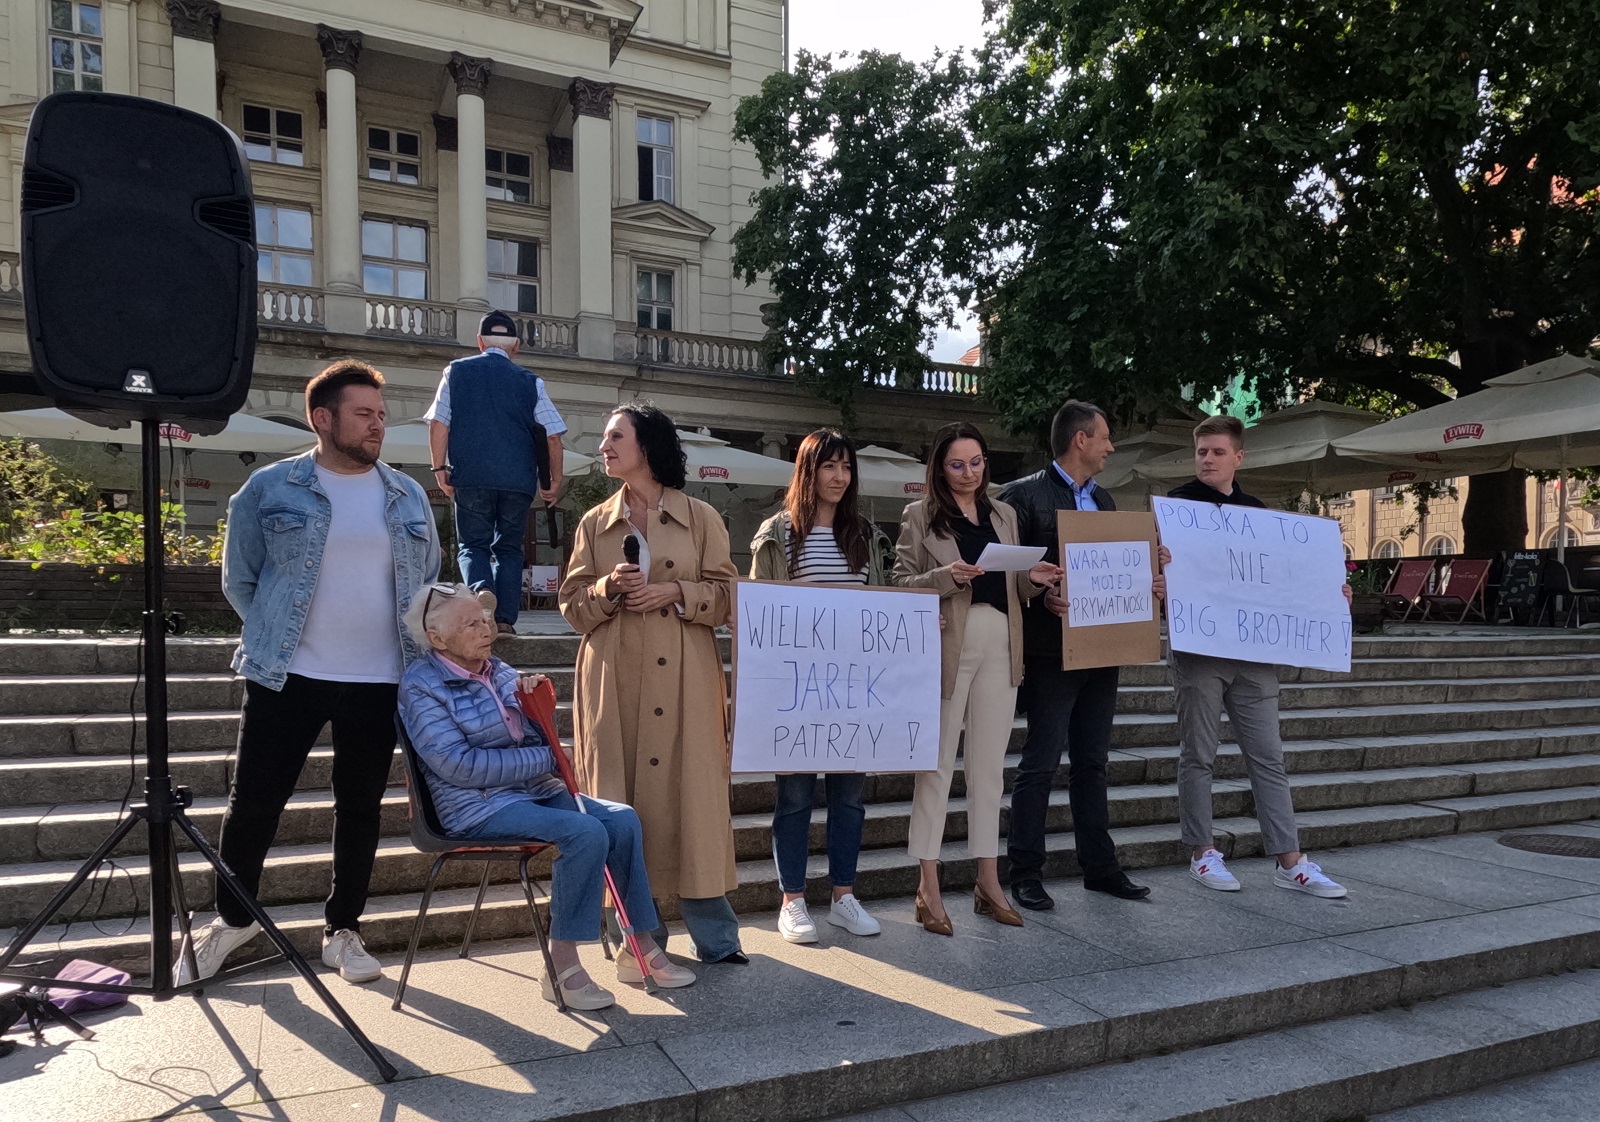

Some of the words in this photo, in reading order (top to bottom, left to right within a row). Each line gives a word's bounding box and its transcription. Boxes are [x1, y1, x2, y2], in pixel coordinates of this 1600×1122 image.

[1160, 502, 1256, 540] POLSKA
[1272, 516, 1309, 544] TO
[1067, 550, 1110, 571] WARA
[1123, 548, 1140, 567] OD
[1226, 545, 1271, 585] NIE
[1091, 574, 1133, 592] MOJEJ
[1072, 592, 1150, 622] PRYWATNOŚCI
[1171, 598, 1217, 637] BIG
[744, 601, 836, 651] WIELKI
[861, 608, 932, 655] BRAT
[777, 660, 887, 712] JAREK
[1198, 864, 1209, 876] N
[1294, 872, 1310, 886] N
